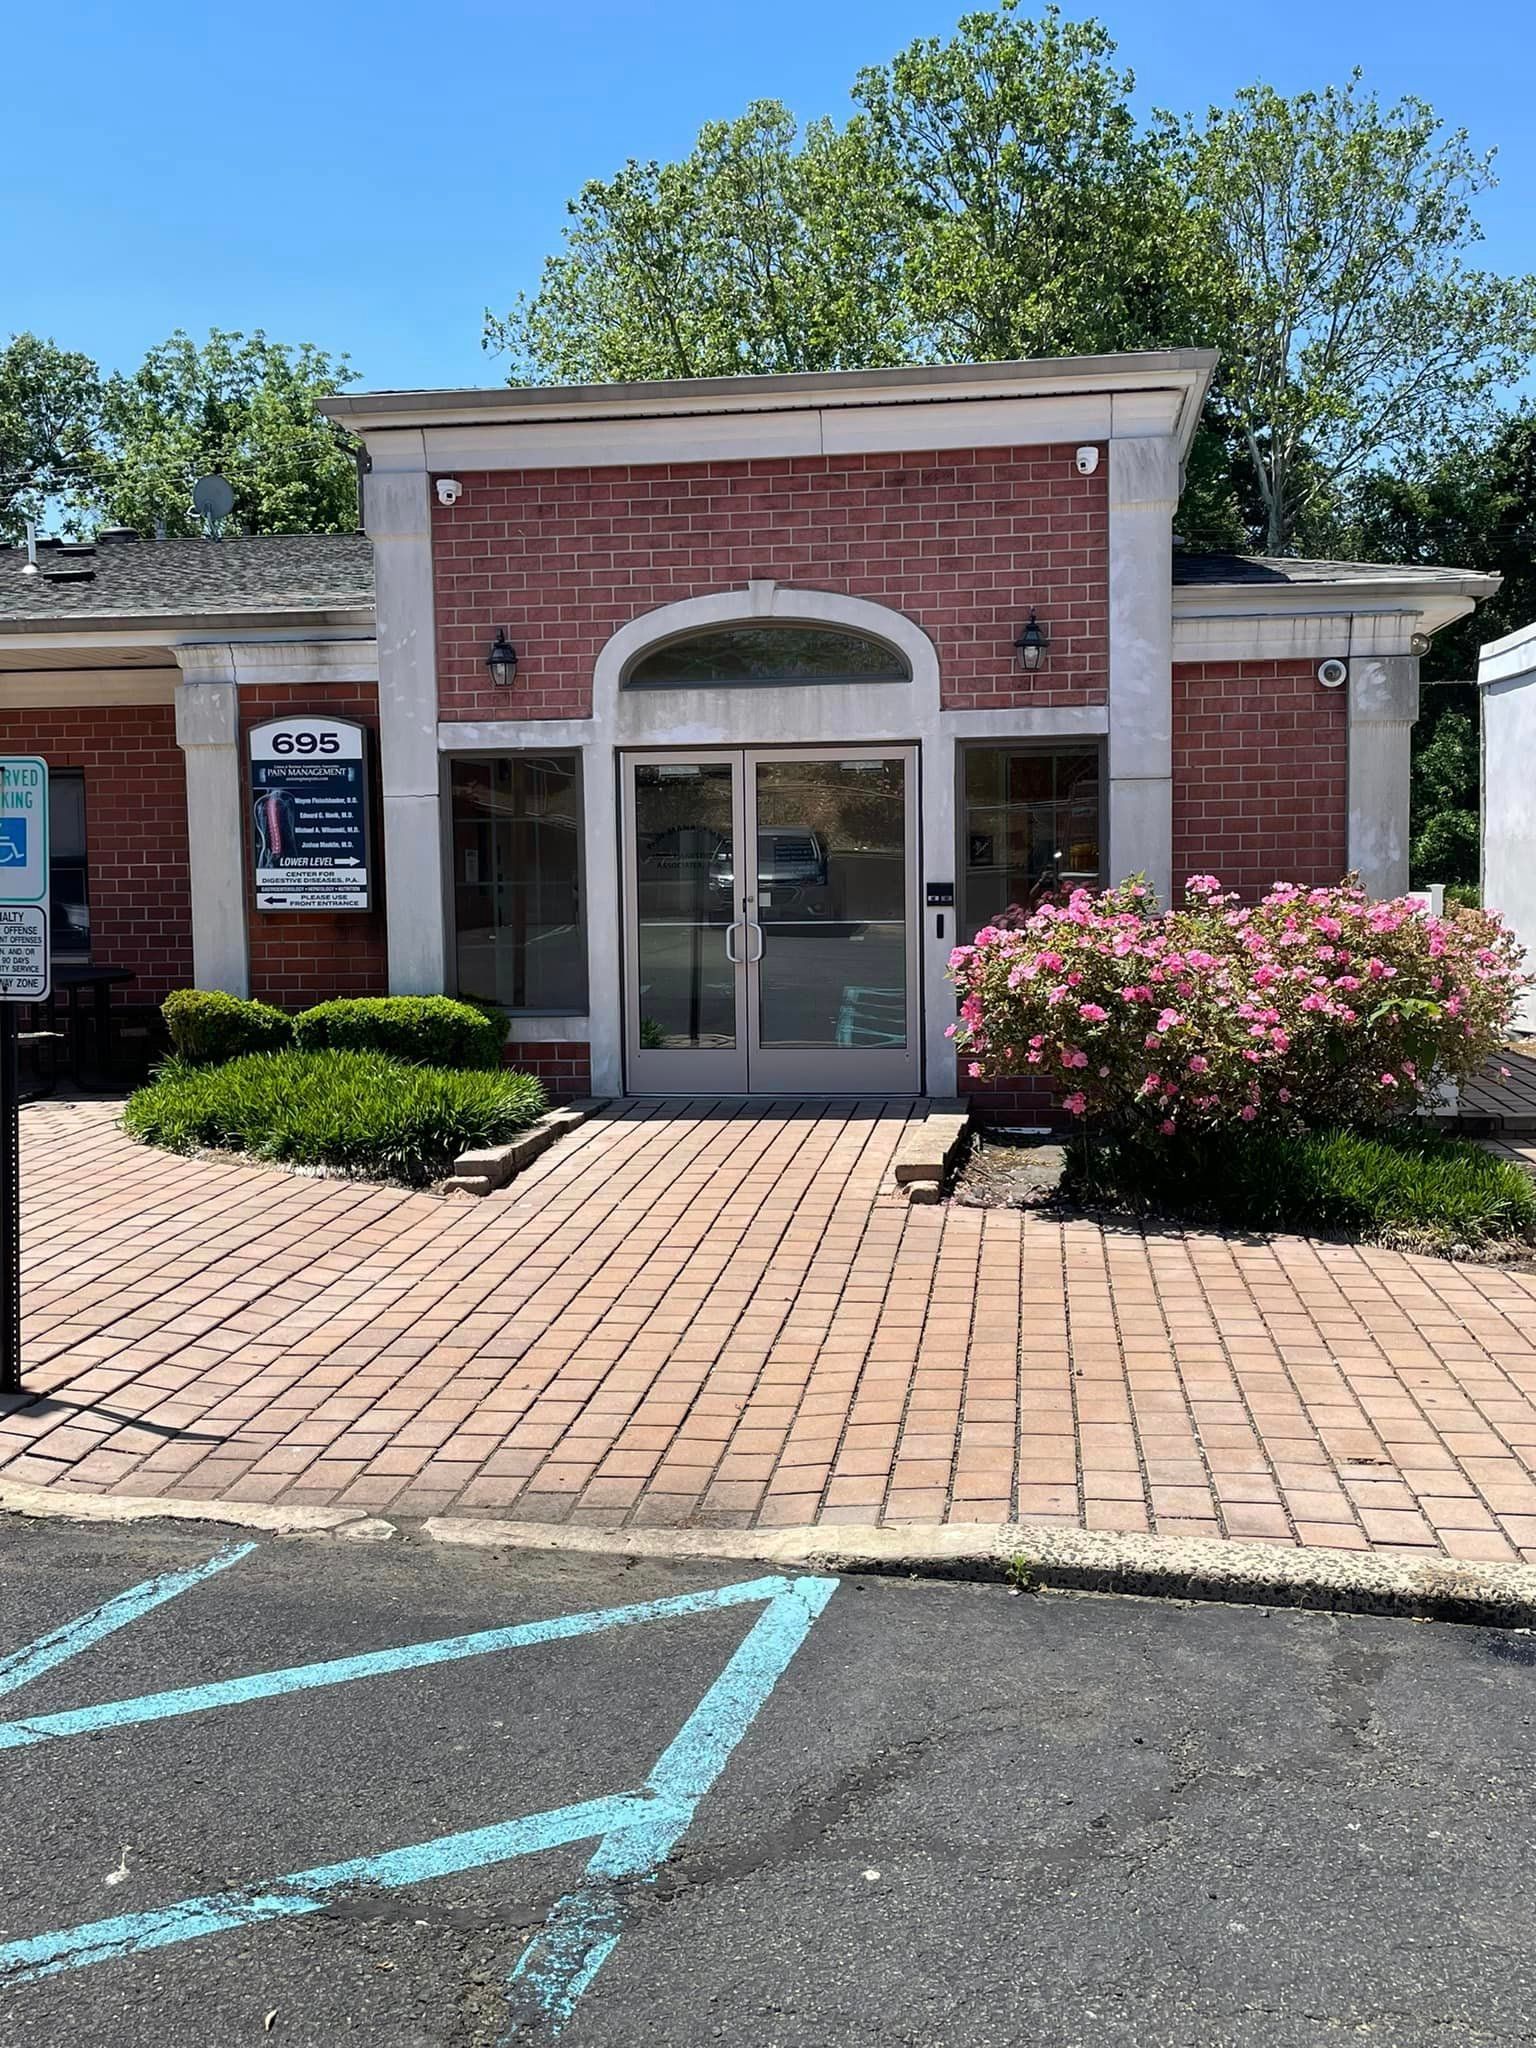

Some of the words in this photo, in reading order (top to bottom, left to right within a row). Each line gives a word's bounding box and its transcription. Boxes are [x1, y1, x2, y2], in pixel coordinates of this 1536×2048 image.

[271, 732, 340, 755] 695
[267, 768, 287, 777] PAIN
[288, 767, 347, 776] MANAGEMENT
[3, 769, 38, 787] RVED
[280, 857, 310, 867] LOWER
[310, 857, 334, 866] LEVEL
[4, 926, 38, 935] OFFENSE
[12, 965, 39, 973] SERVICE
[16, 979, 39, 988] ZONE
